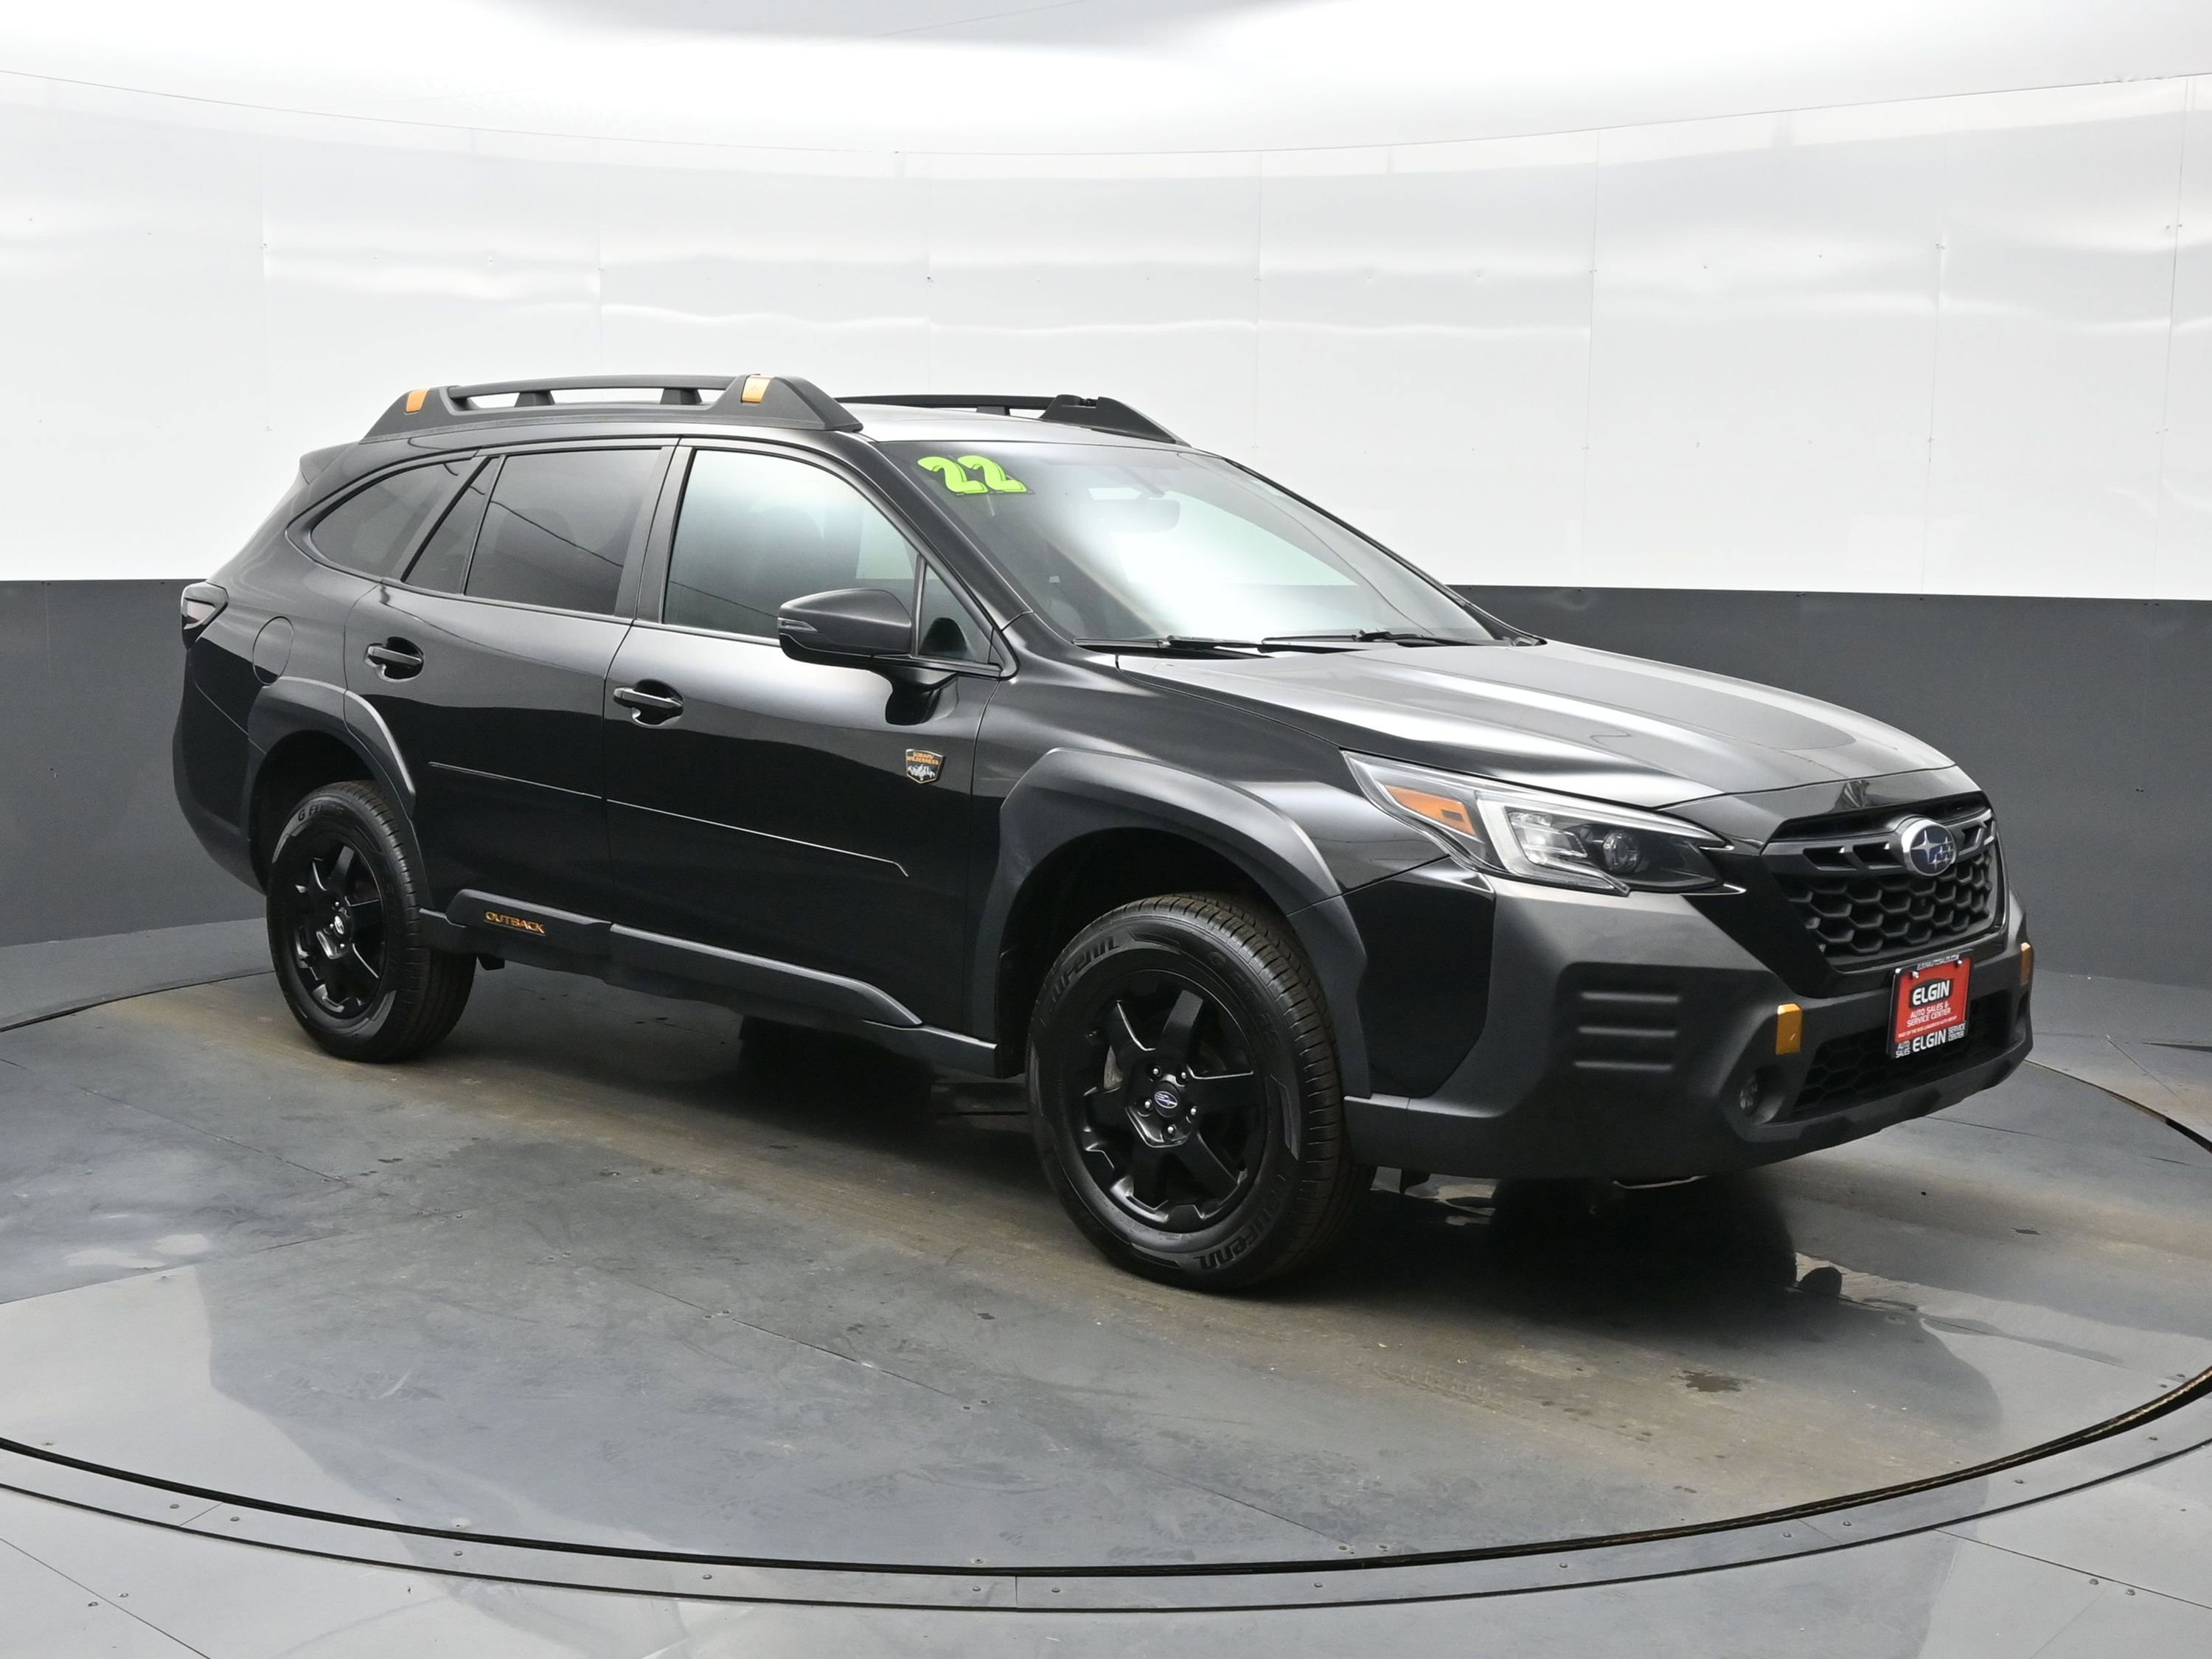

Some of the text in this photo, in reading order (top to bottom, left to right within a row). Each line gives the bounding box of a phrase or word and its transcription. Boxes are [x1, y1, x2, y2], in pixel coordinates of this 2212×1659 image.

[917, 455, 1027, 494] 22
[485, 911, 545, 934] OUTBACK
[1913, 980, 1950, 1005] ELGIN
[1907, 1013, 1930, 1028] SERVICE
[1930, 1006, 1952, 1020] CENTER
[1910, 1001, 1950, 1019] AUTO SALES &
[1947, 1031, 1965, 1042] CENTER
[1948, 1023, 1966, 1034] SERVICE
[1897, 1040, 1911, 1050] AUTO
[1912, 1029, 1947, 1053] ELGIN
[1895, 1048, 1911, 1059] SALES
